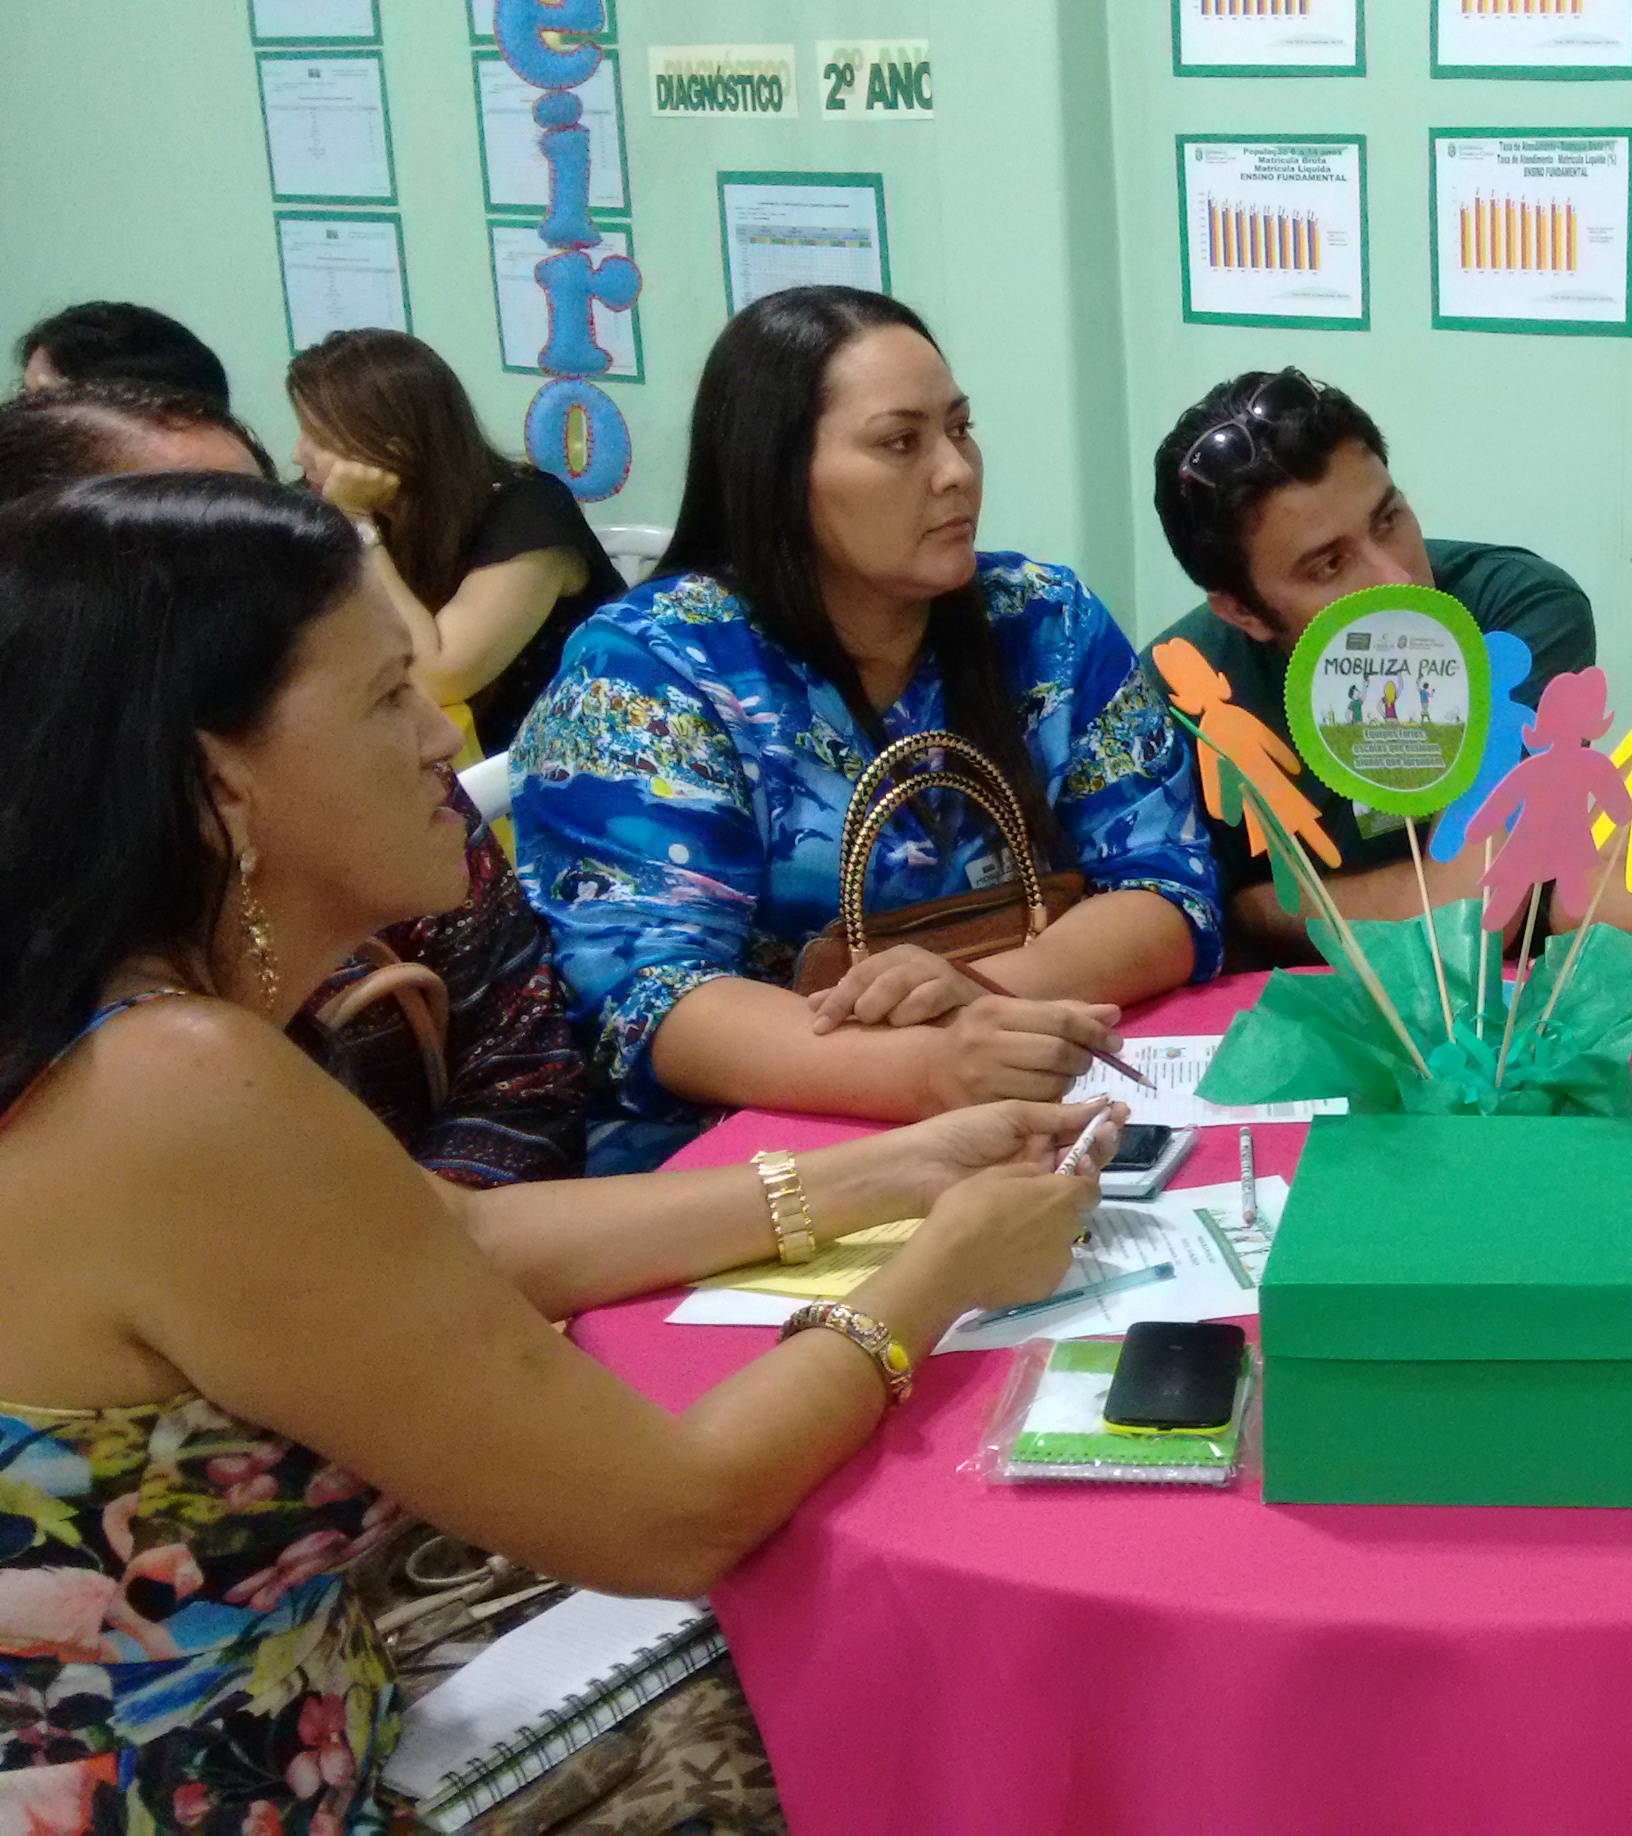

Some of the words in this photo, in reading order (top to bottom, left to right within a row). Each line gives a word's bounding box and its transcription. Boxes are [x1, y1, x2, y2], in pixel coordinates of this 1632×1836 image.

[655, 65, 783, 112] DIAGNÓSTICO
[1240, 173, 1275, 181] ENSINO
[1276, 173, 1347, 182] FUNDAMENTAL
[1324, 657, 1411, 677] MOBILIZA
[1418, 658, 1457, 678] PAIC
